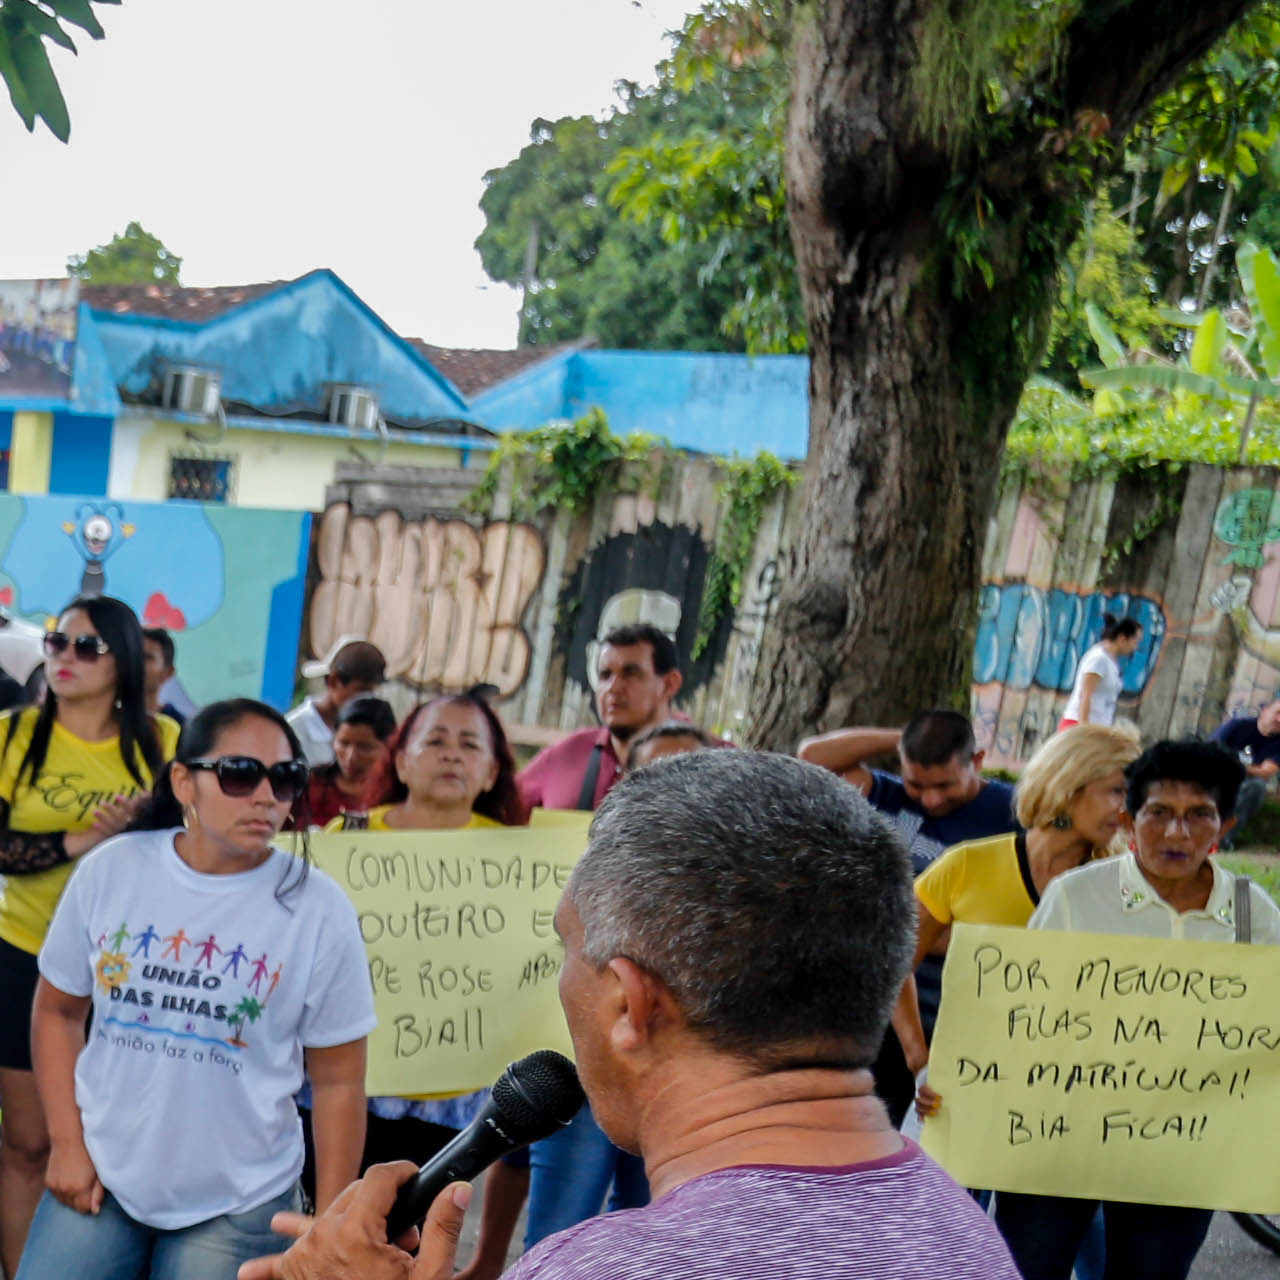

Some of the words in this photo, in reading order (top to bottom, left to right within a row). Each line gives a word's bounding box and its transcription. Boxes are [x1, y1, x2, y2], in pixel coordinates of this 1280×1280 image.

[142, 964, 222, 990] UNIÃO
[417, 960, 494, 1000] ROSE
[974, 943, 1049, 999] POR
[1075, 957, 1248, 1003] MENORES
[109, 986, 154, 1007] DAS
[161, 995, 228, 1021] ILHAS
[1114, 1015, 1168, 1046] NA
[1196, 1017, 1280, 1050] HOR
[162, 1040, 188, 1060] faz
[193, 1050, 204, 1063] a
[958, 1058, 1009, 1087] DA
[1008, 1110, 1070, 1146] BIA
